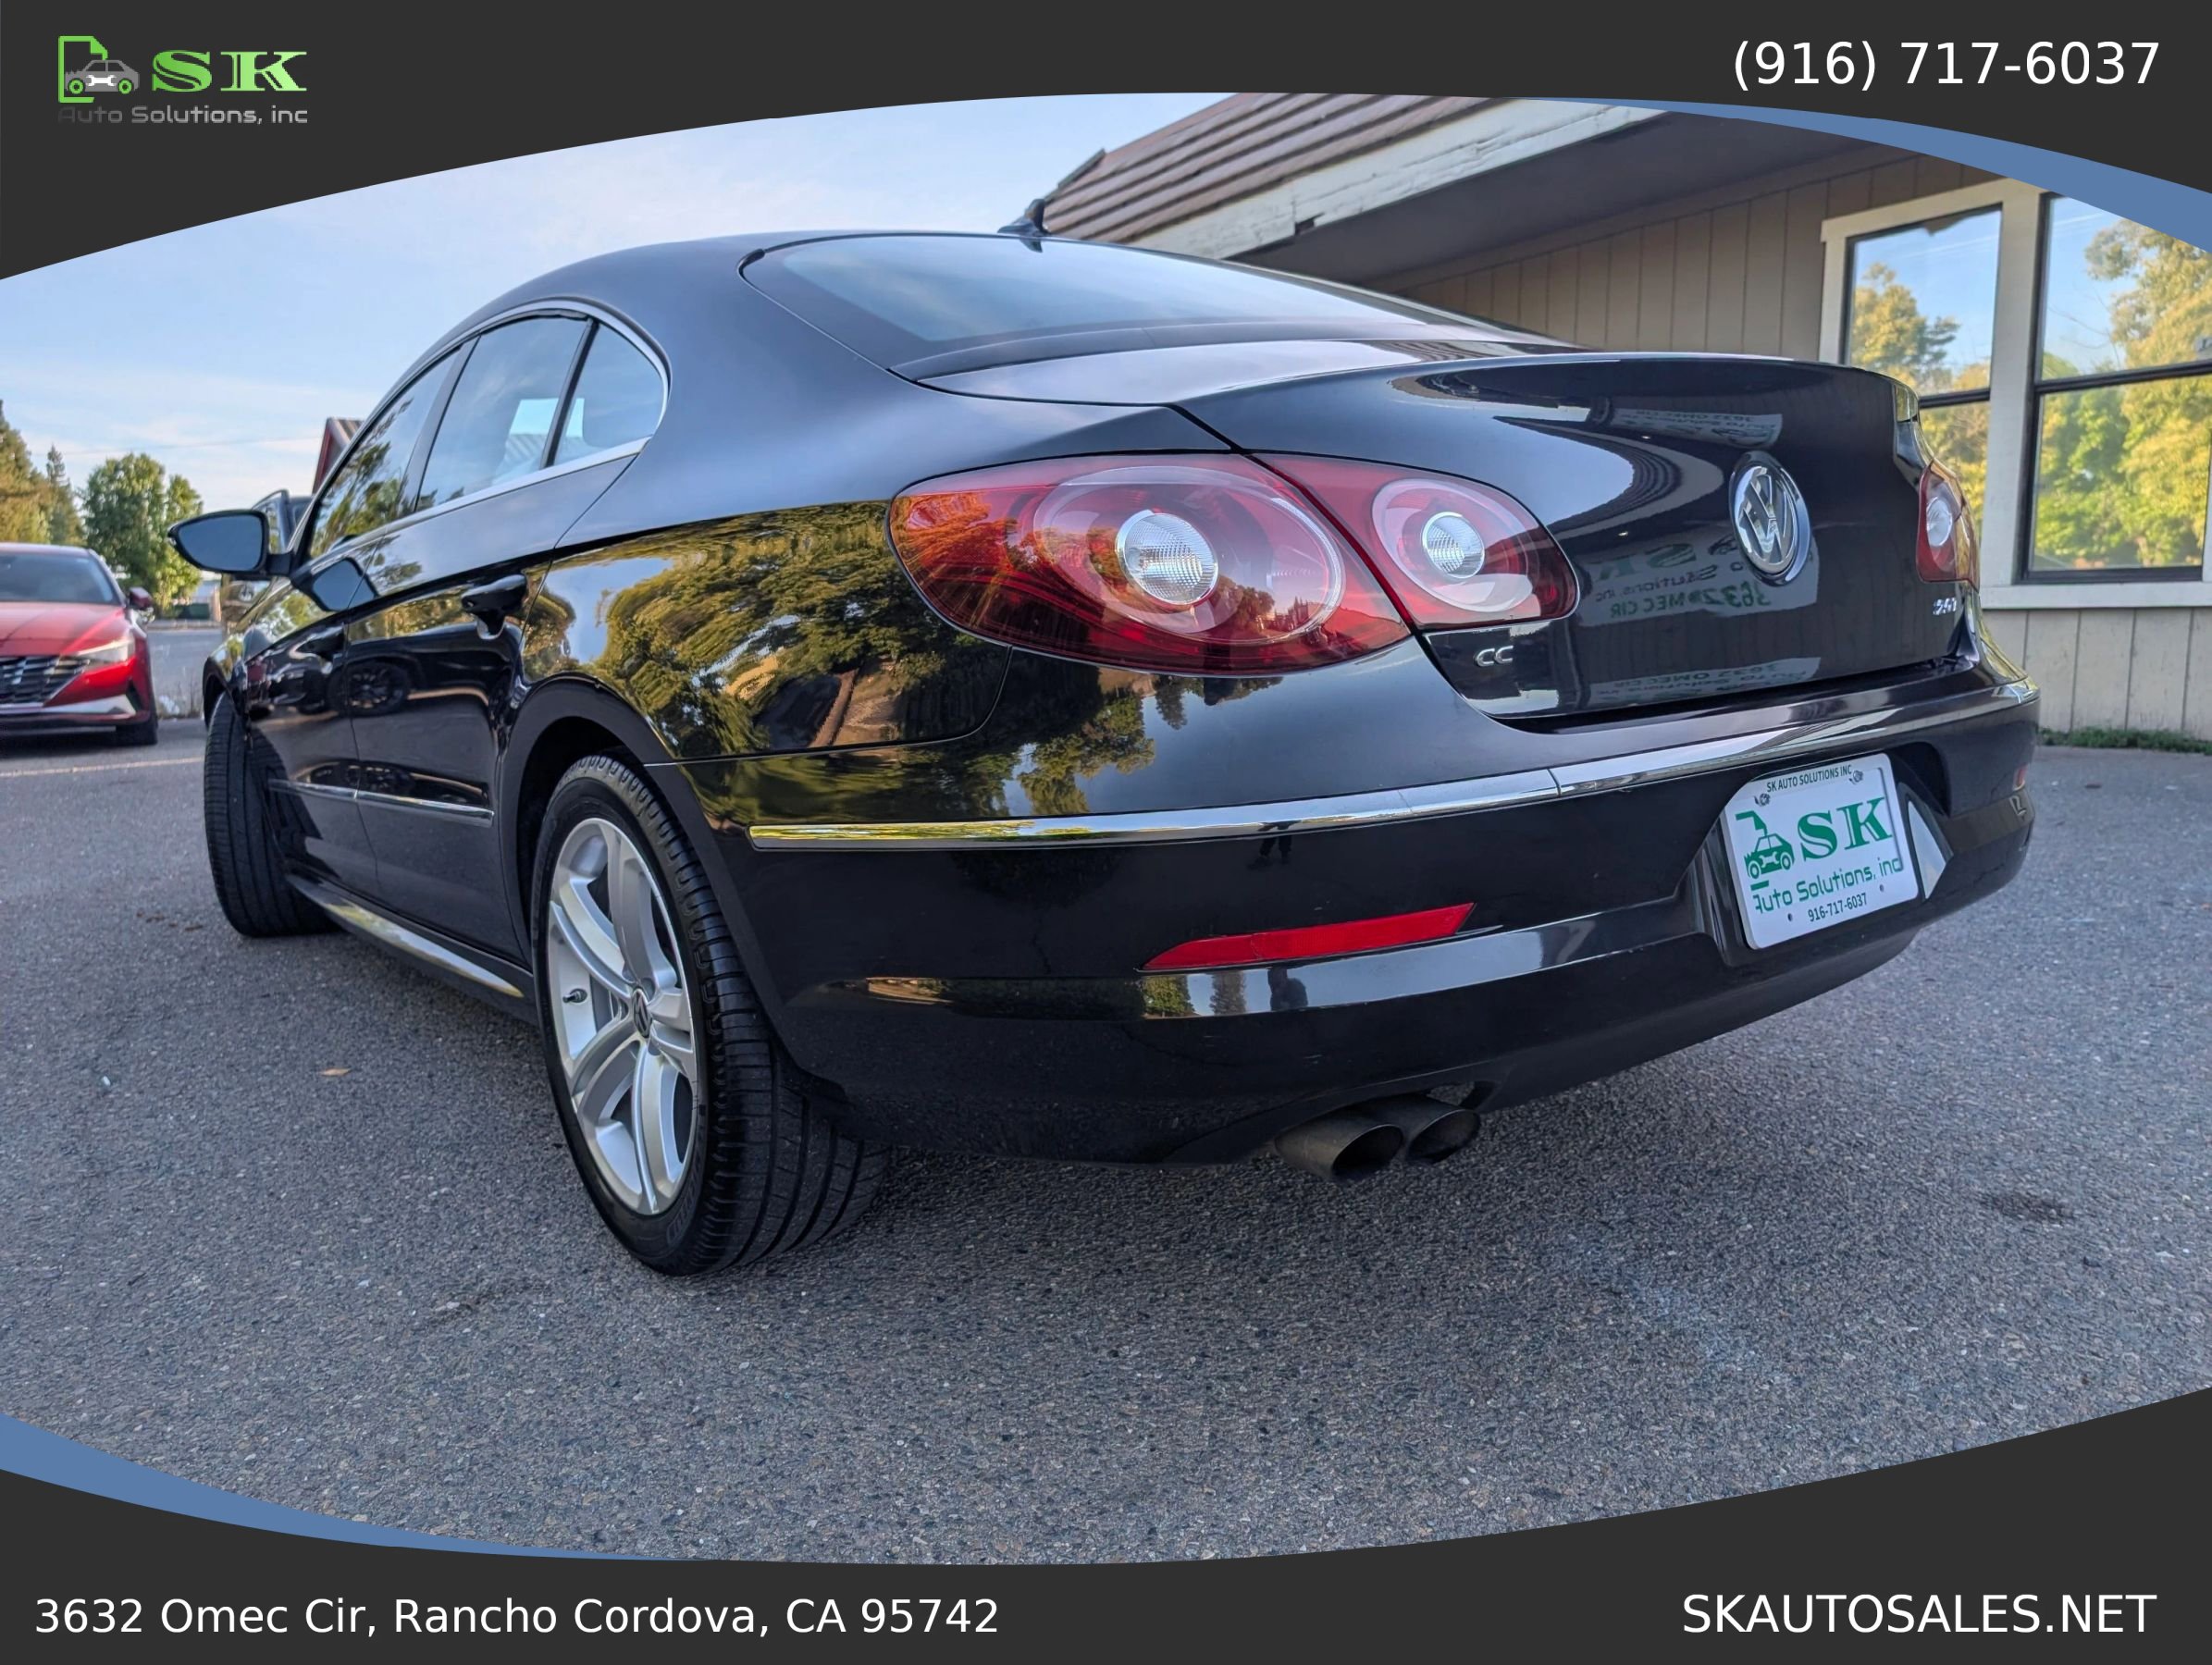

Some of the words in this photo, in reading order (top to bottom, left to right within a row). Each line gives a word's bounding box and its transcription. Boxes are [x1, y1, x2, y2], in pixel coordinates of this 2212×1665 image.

[1474, 645, 1514, 667] CC
[1766, 781, 1777, 793] SK
[1777, 776, 1798, 790] AUTO
[1798, 767, 1839, 785] SOLUTIONS
[1839, 764, 1852, 777] INC
[1797, 796, 1893, 862] SK
[1796, 866, 1876, 902] Solutions,
[1878, 857, 1903, 877] inc
[1808, 892, 1868, 922] 916-717-6037
